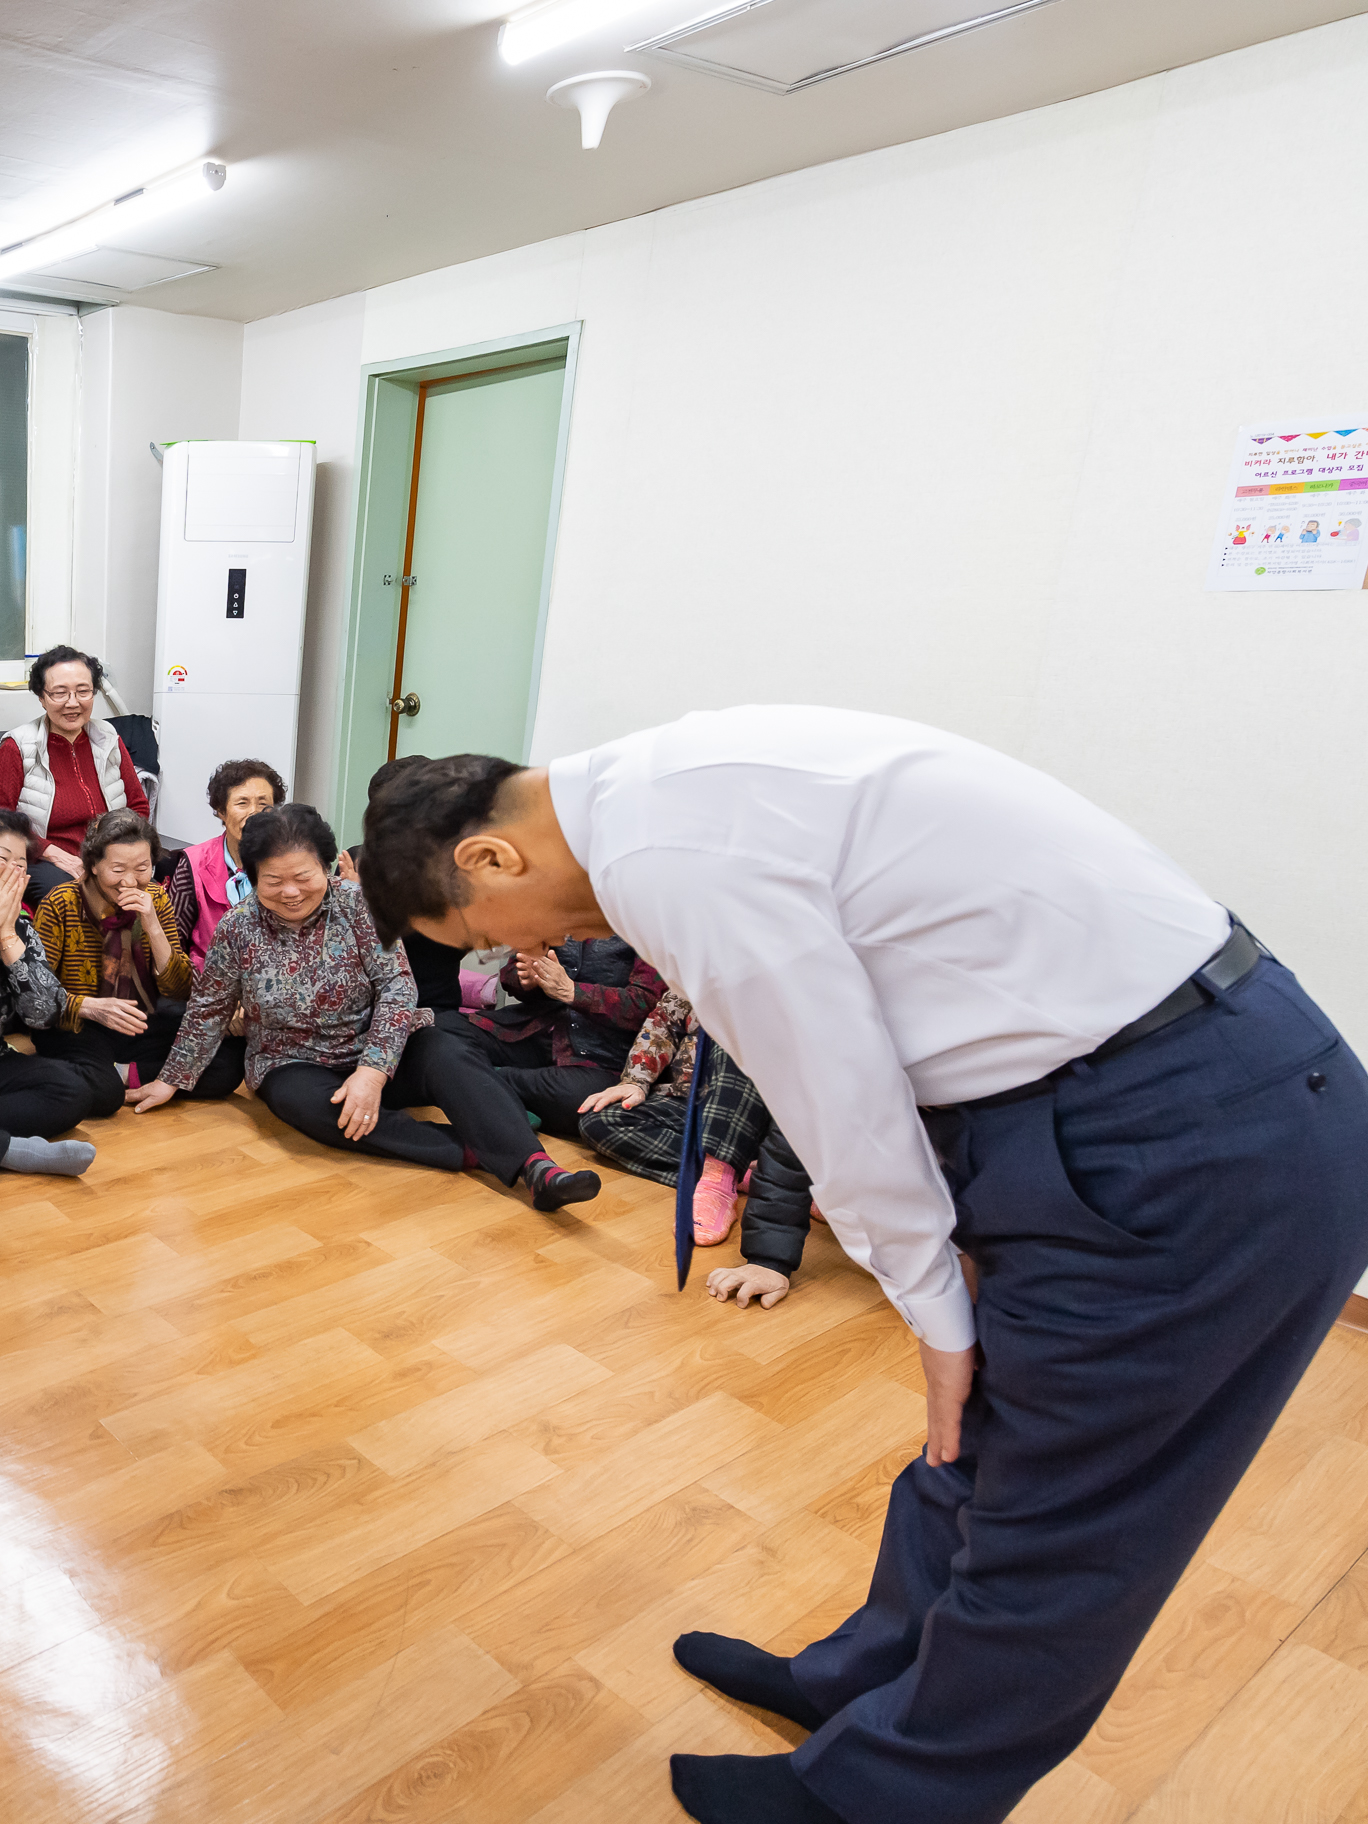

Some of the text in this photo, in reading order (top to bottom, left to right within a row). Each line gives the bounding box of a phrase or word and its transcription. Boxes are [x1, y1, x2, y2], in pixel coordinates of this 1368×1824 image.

[1326, 452, 1348, 461] 내가
[1354, 450, 1368, 460] 간
[1282, 468, 1314, 476] 프로그램
[1318, 466, 1343, 474] 대상자
[1347, 464, 1364, 472] 모집
